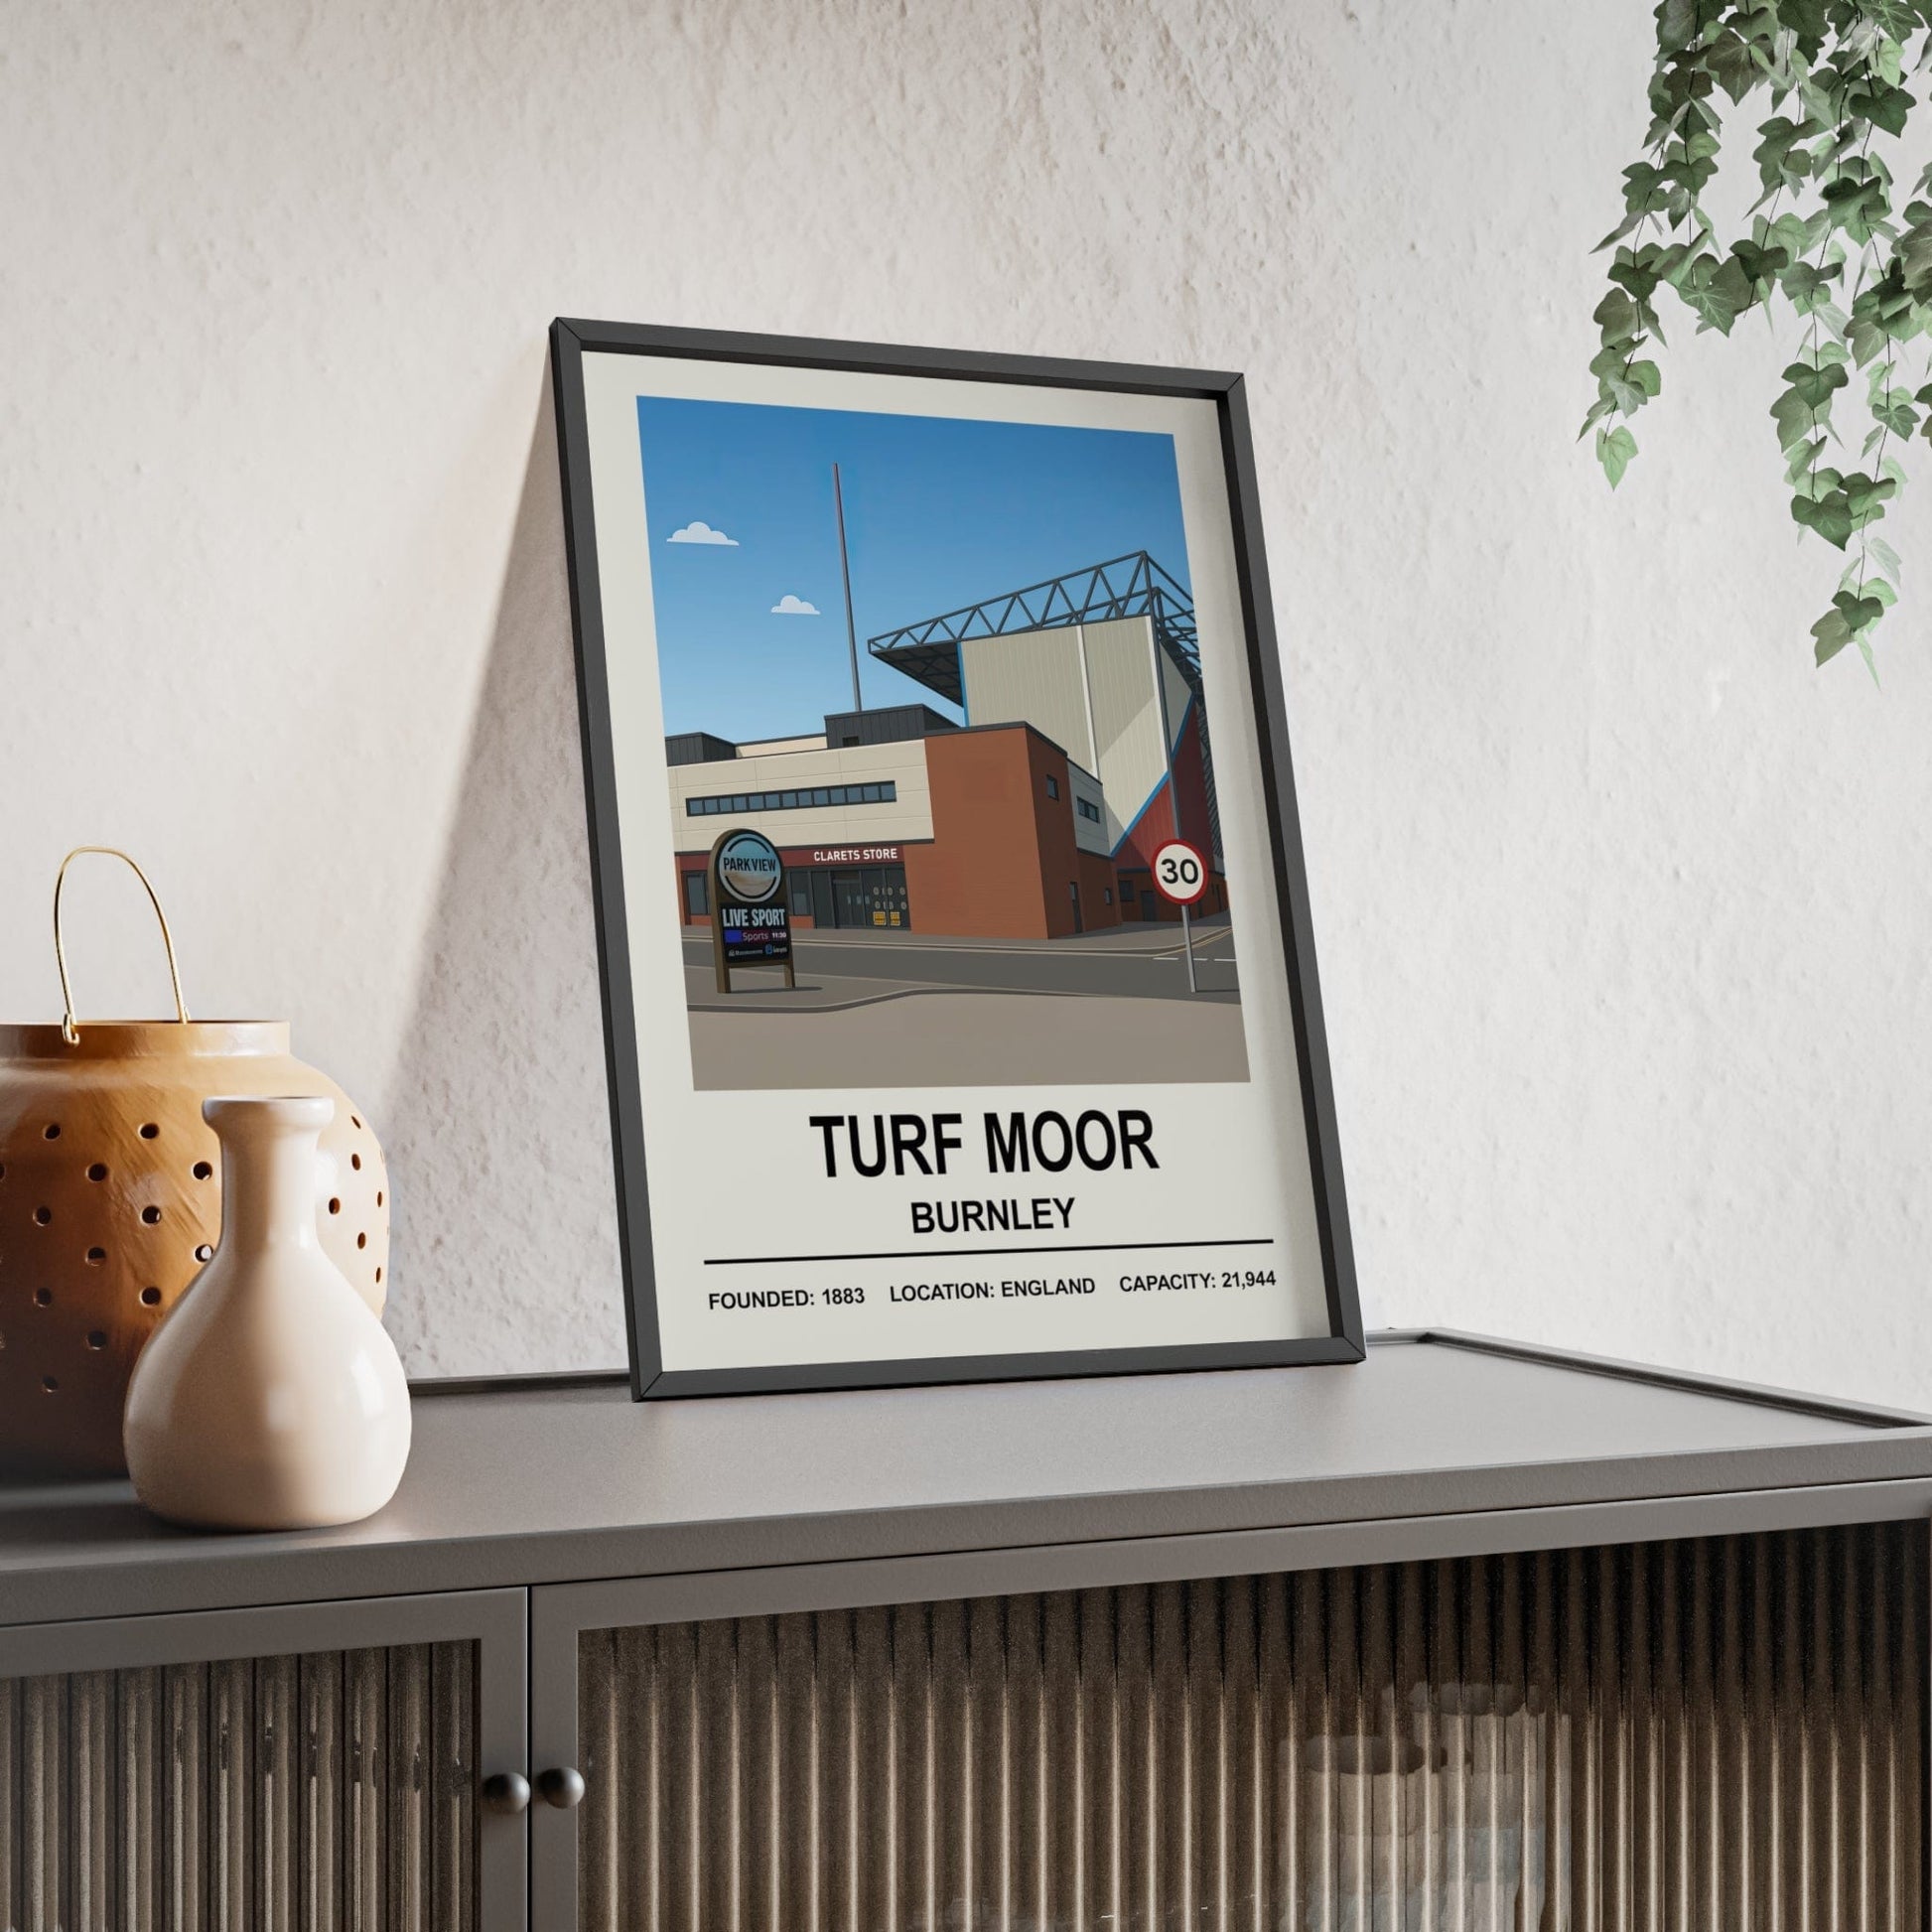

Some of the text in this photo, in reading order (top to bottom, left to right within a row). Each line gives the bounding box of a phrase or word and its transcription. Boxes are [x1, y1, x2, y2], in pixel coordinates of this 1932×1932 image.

[723, 857, 776, 872] PARK VIEW
[814, 848, 898, 862] CLARETS STORE
[1161, 858, 1199, 885] 30
[722, 908, 785, 927] LIVE SPORT
[742, 931, 769, 943] Sports
[808, 1109, 1161, 1178] TURF MOOR
[910, 1196, 1075, 1234] BURNLEY
[708, 1270, 1277, 1311] FOUNDED: 1883 LOCATION: ENGLAND CAPACITY: 21,944
